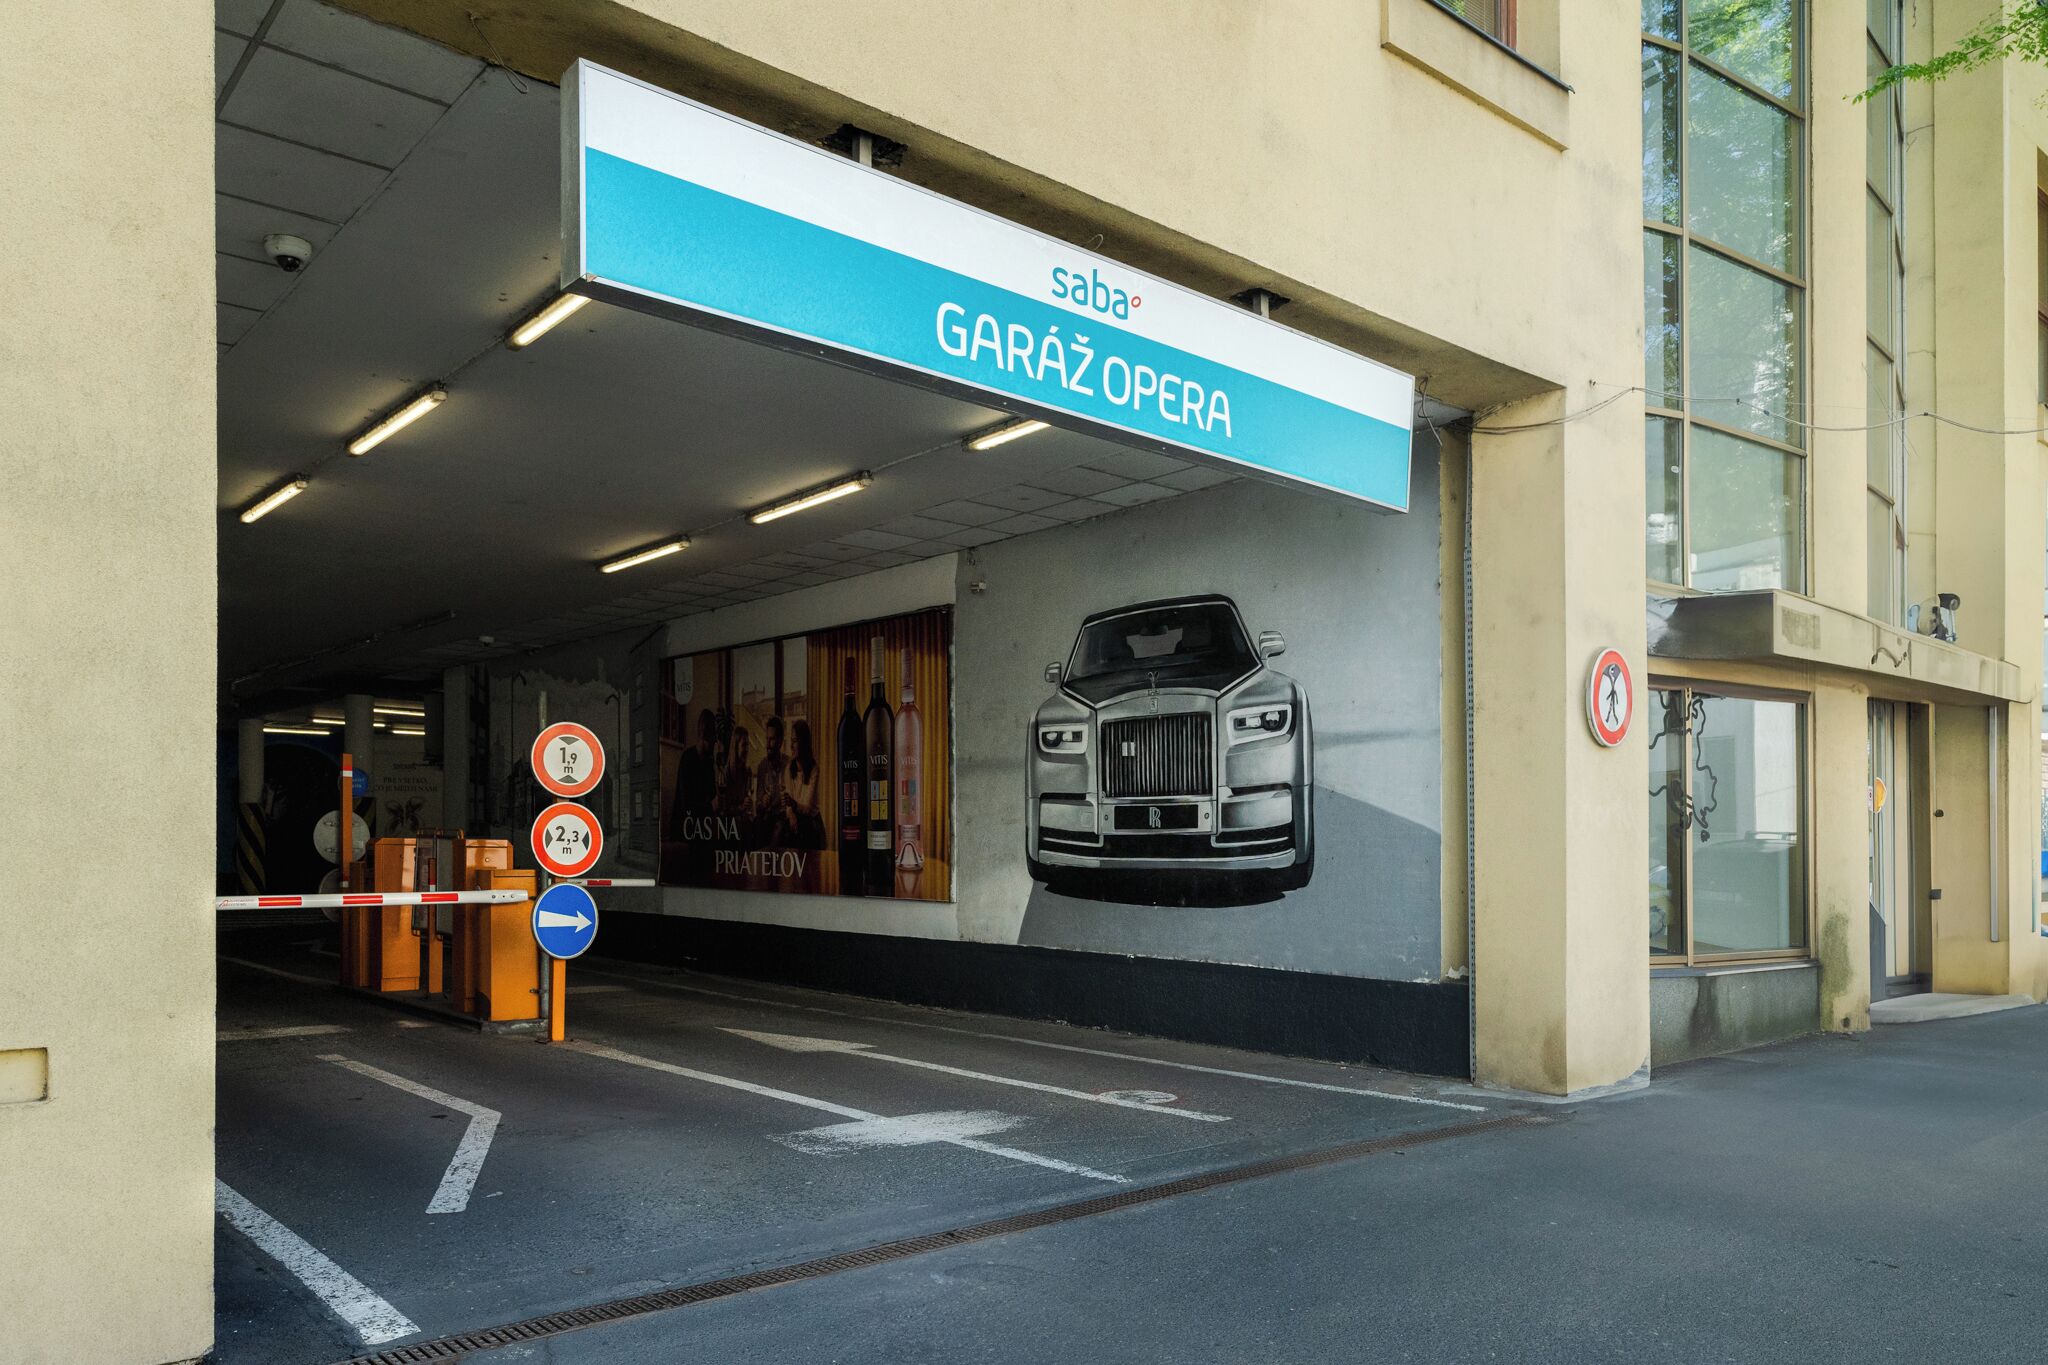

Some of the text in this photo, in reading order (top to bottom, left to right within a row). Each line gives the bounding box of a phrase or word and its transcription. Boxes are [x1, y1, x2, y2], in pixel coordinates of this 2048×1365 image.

[1051, 266, 1129, 320] saba
[936, 302, 1232, 438] GARÁŽ OPERA
[559, 746, 578, 765] 1,9
[843, 760, 859, 769] VITIS
[870, 754, 888, 765] VITIS
[563, 766, 574, 774] m
[555, 825, 579, 845] 2,3
[683, 810, 741, 841] ČAS NA
[562, 846, 572, 854] m
[714, 850, 807, 878] PRIATEĽOV
